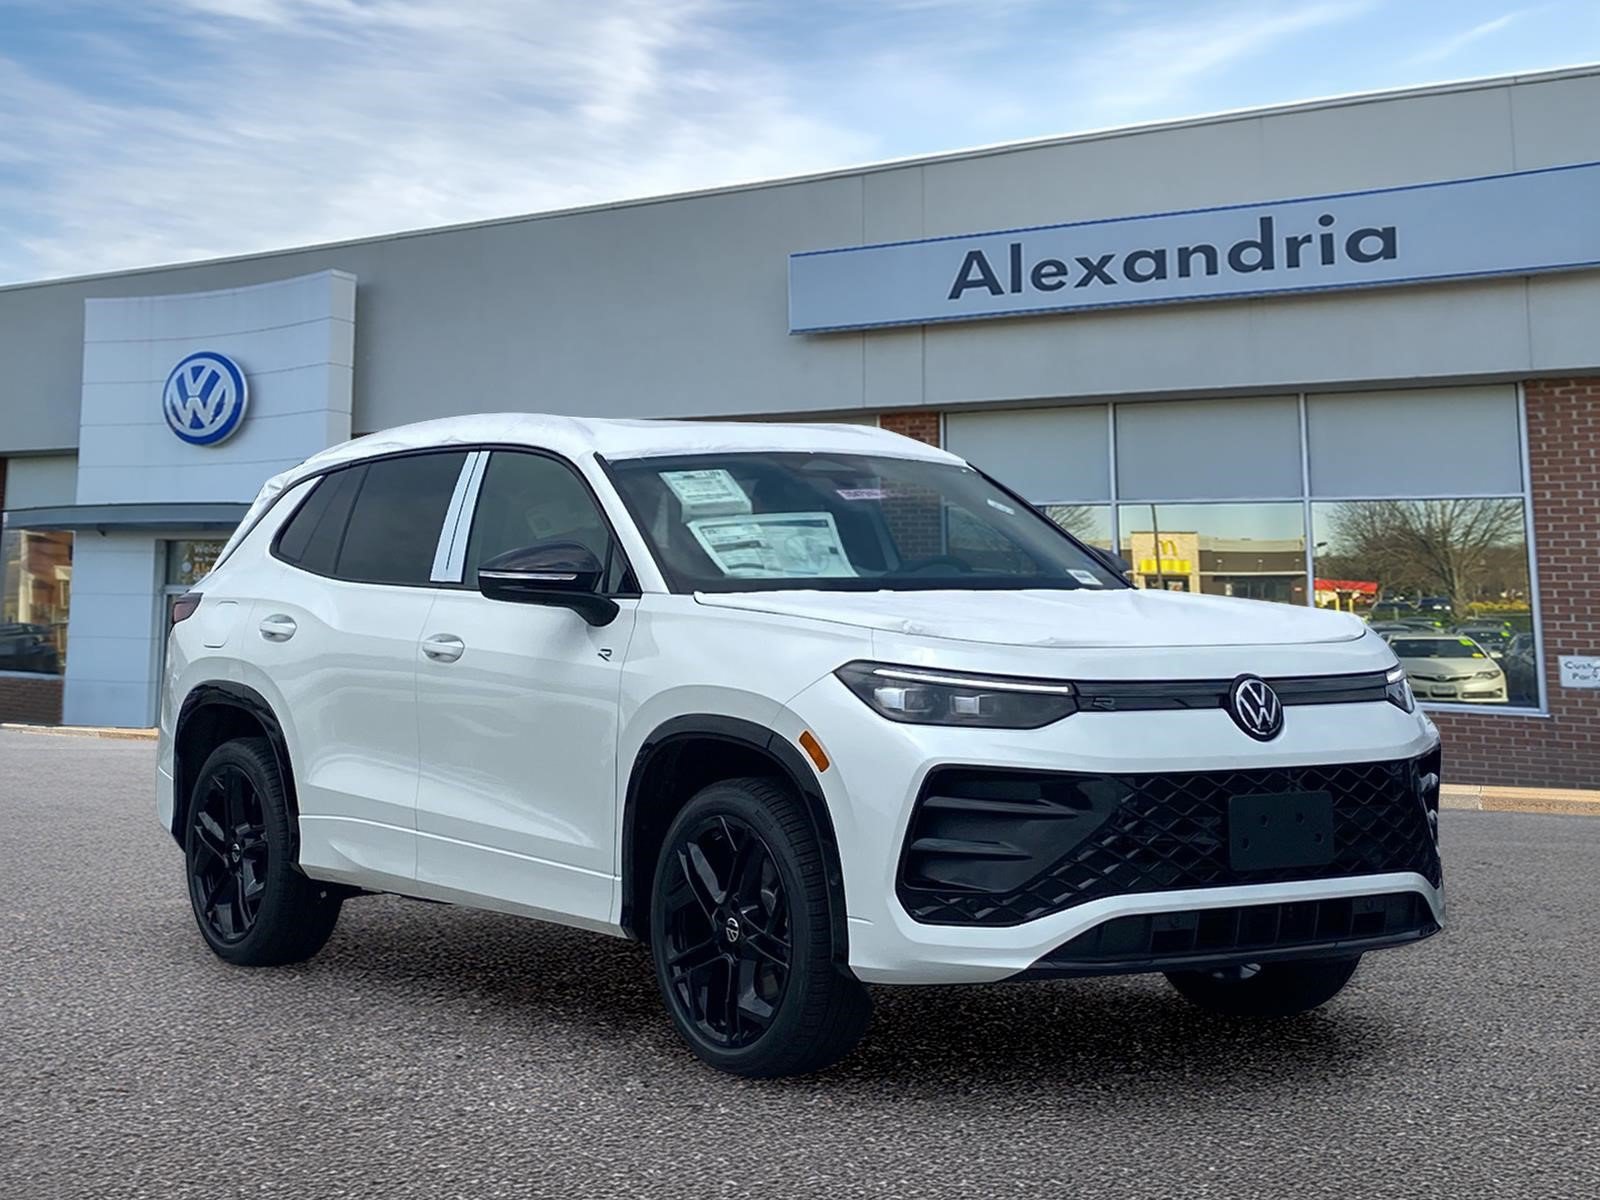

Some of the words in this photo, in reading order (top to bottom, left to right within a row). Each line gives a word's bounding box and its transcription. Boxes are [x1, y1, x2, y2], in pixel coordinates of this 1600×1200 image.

[948, 214, 1397, 300] Alexandria
[165, 358, 237, 437] VW
[597, 648, 613, 662] R
[1235, 679, 1282, 735] VW
